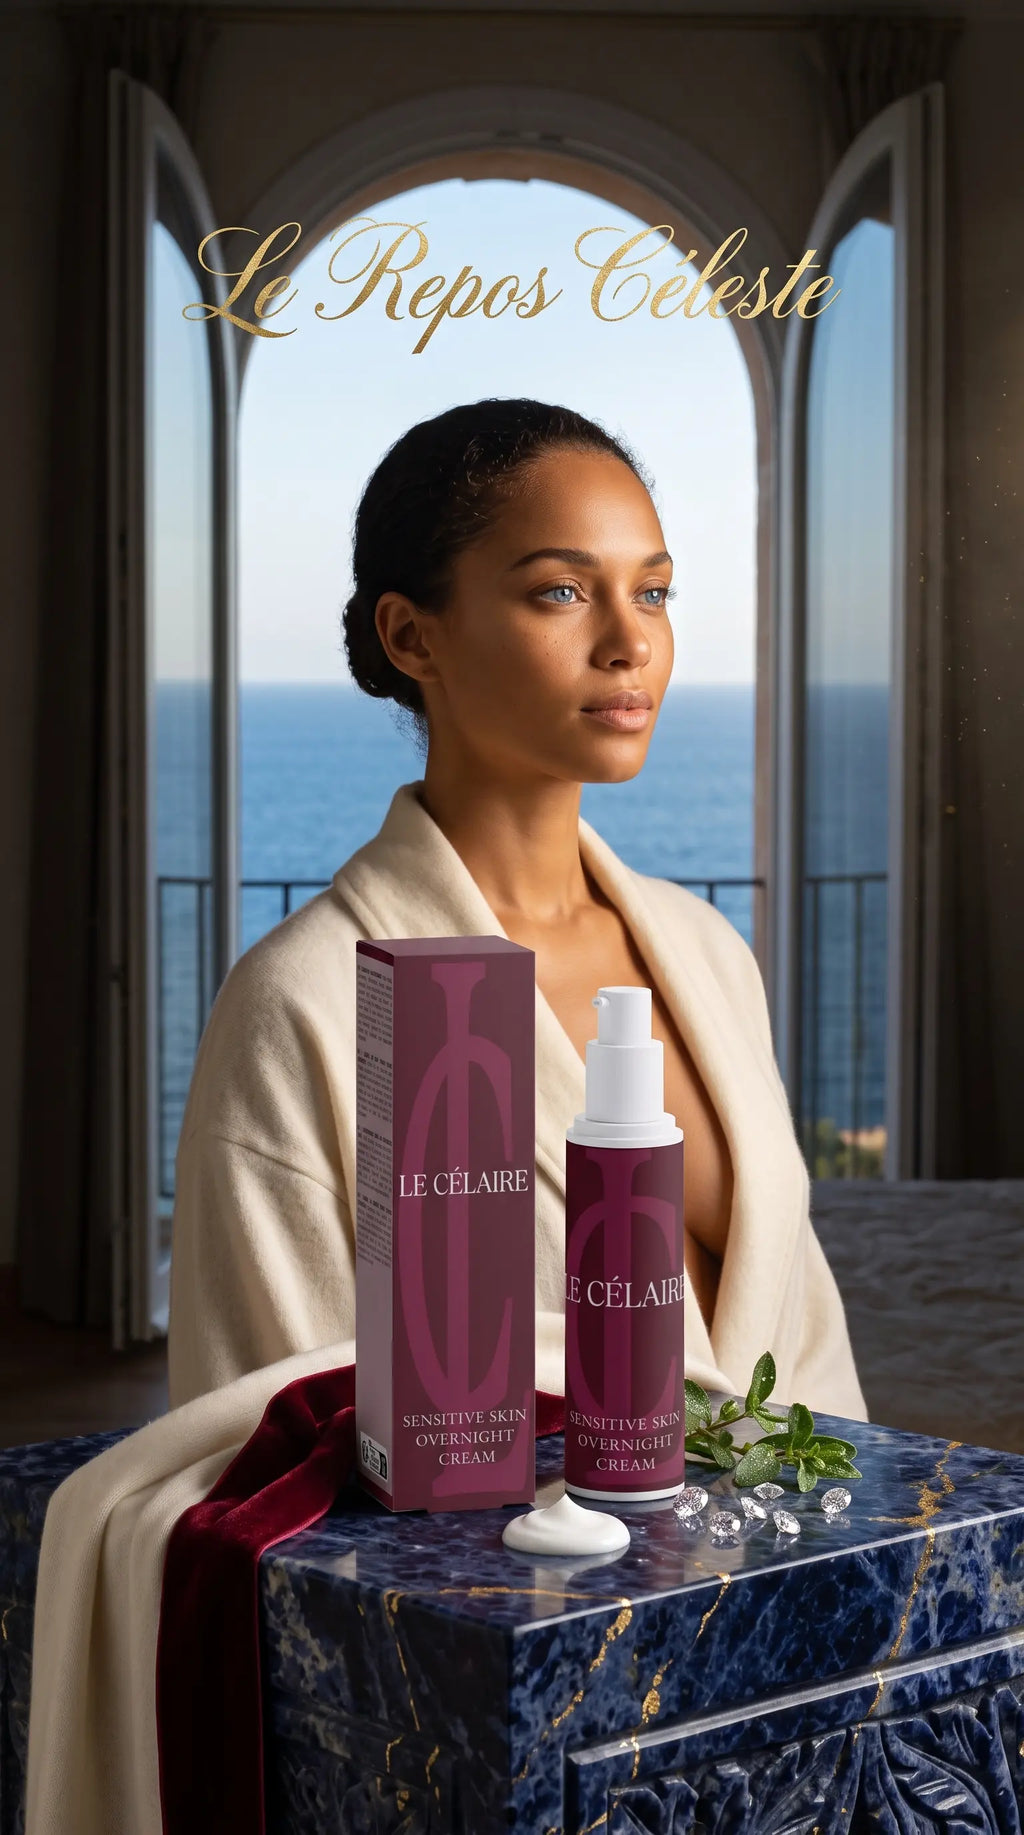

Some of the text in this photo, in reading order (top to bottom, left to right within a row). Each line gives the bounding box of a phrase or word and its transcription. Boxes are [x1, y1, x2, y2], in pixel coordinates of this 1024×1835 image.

[400, 1166, 529, 1197] LE CÉLAIRE
[403, 1409, 527, 1428] SENSITIVE SKIN
[569, 1410, 681, 1431] SENSITIVE SKIN
[416, 1429, 515, 1448] OVERNIGHT
[577, 1433, 673, 1452] OVERNIGHT
[438, 1450, 496, 1466] CREAM
[596, 1457, 656, 1472] CREAM
